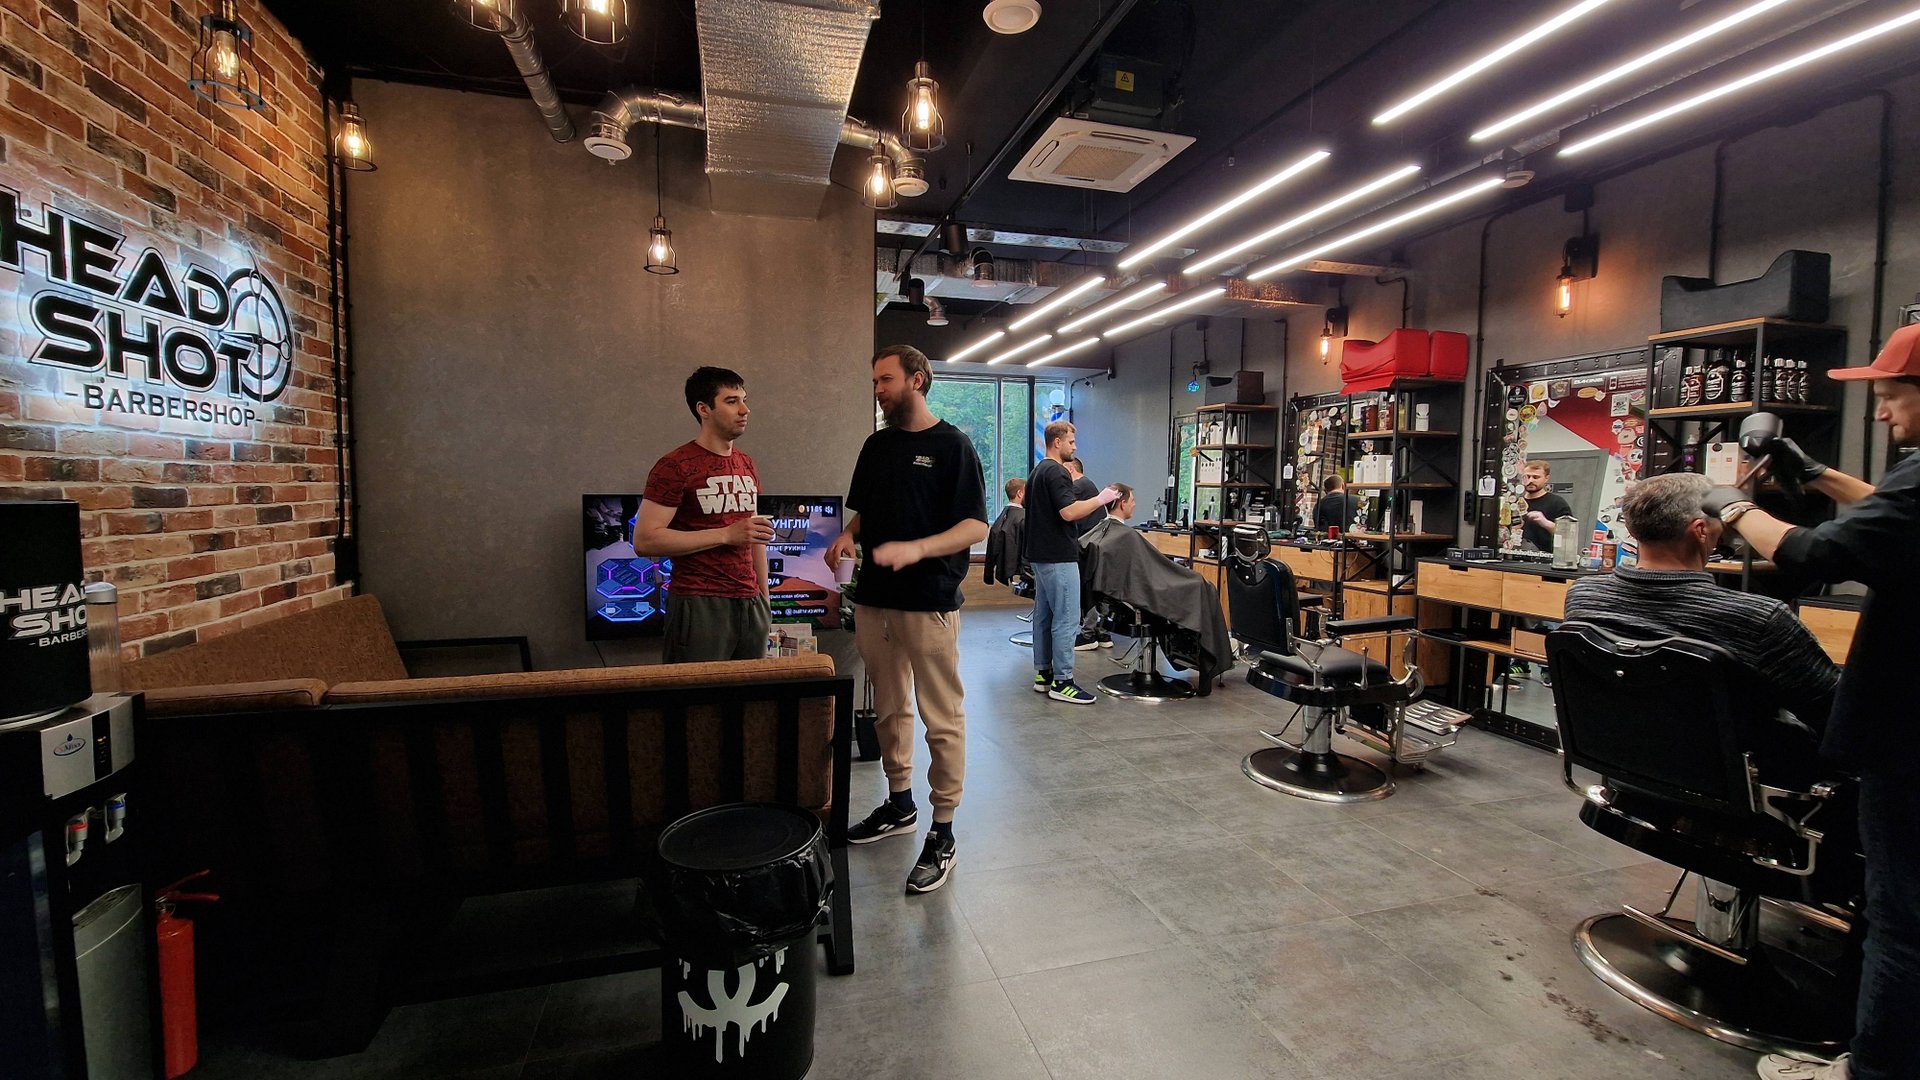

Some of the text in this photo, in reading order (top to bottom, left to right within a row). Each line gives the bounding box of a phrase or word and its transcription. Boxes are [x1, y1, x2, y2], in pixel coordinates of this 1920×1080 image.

[0, 186, 232, 329] HEAD
[32, 292, 253, 396] SHOT
[696, 474, 757, 495] STAR
[771, 518, 810, 529] УНГЛИ
[13, 604, 87, 638] SHO
